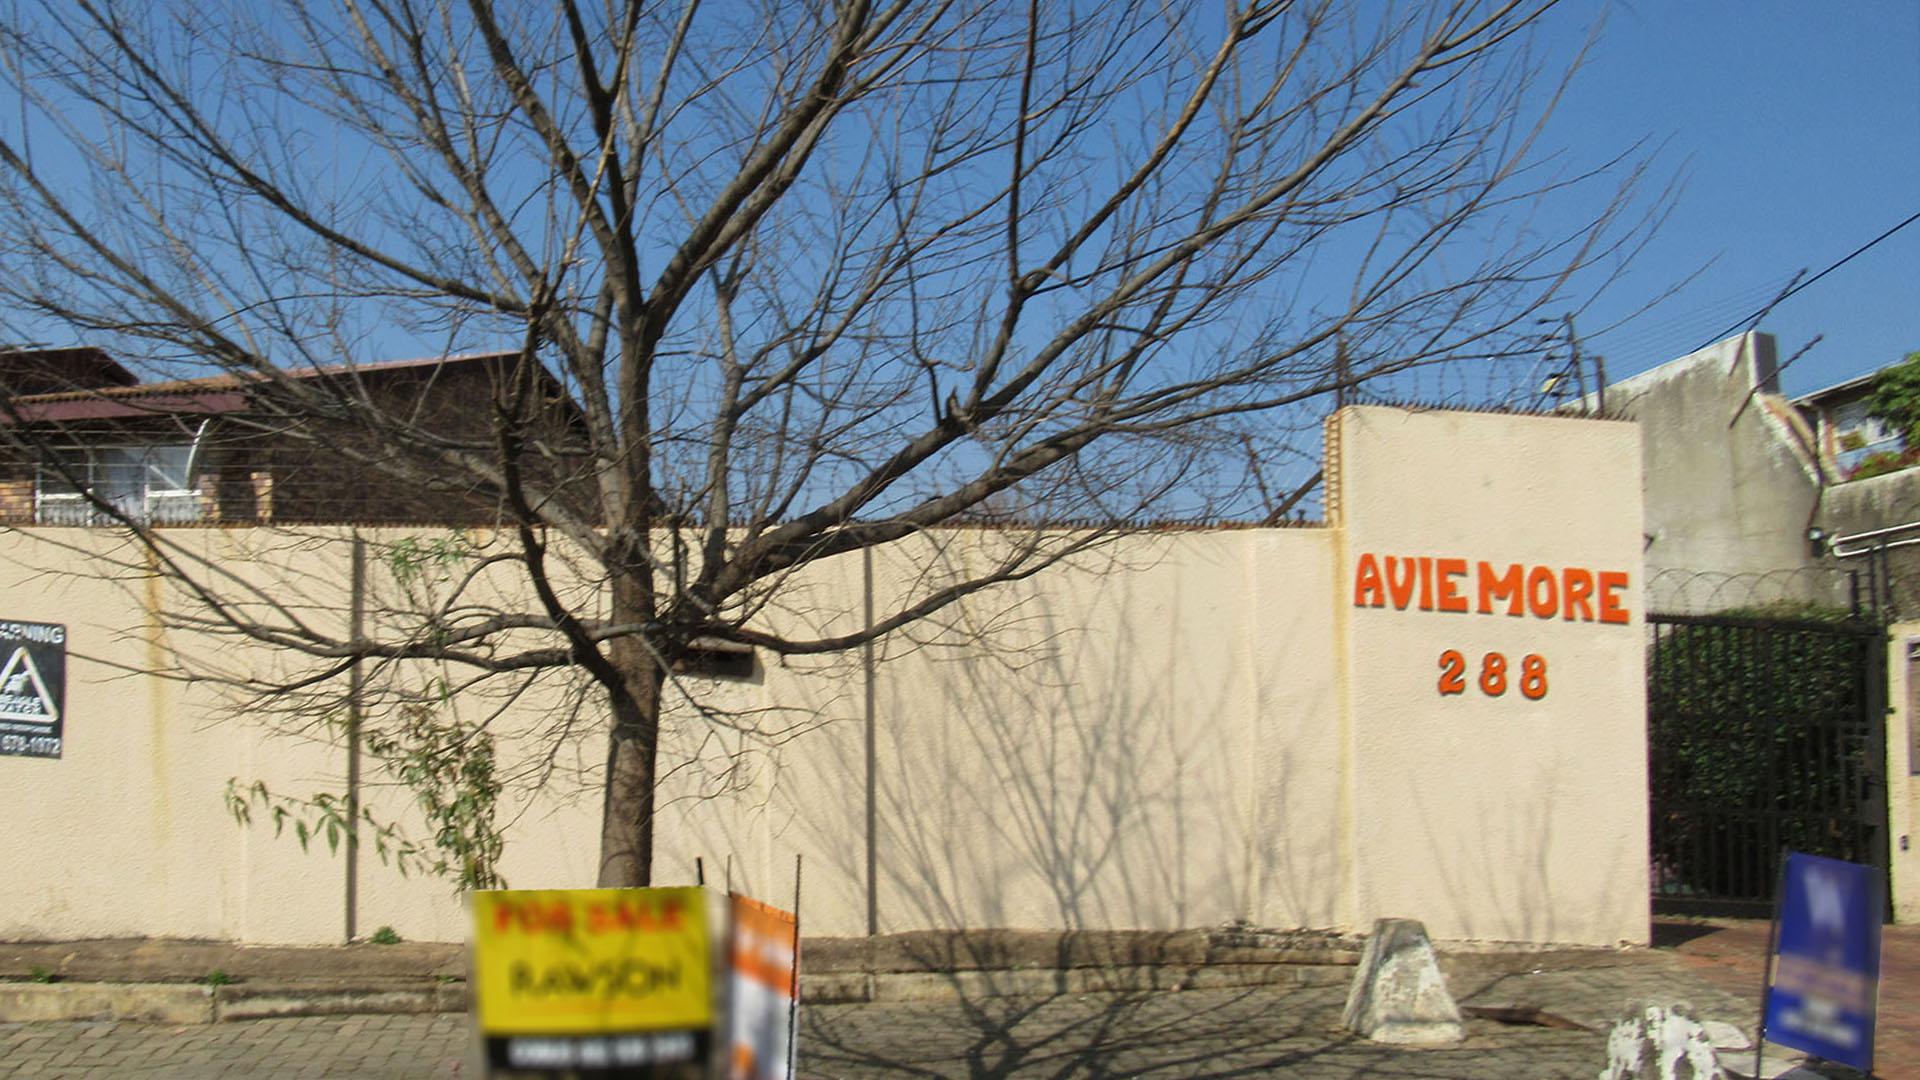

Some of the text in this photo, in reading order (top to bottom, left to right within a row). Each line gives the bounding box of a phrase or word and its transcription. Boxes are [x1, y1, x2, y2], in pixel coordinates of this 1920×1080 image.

[1354, 553, 1630, 625] AVIEMORE
[1438, 649, 1548, 700] 288
[493, 898, 685, 936] FOR SALE
[508, 958, 682, 998] RAWSON
